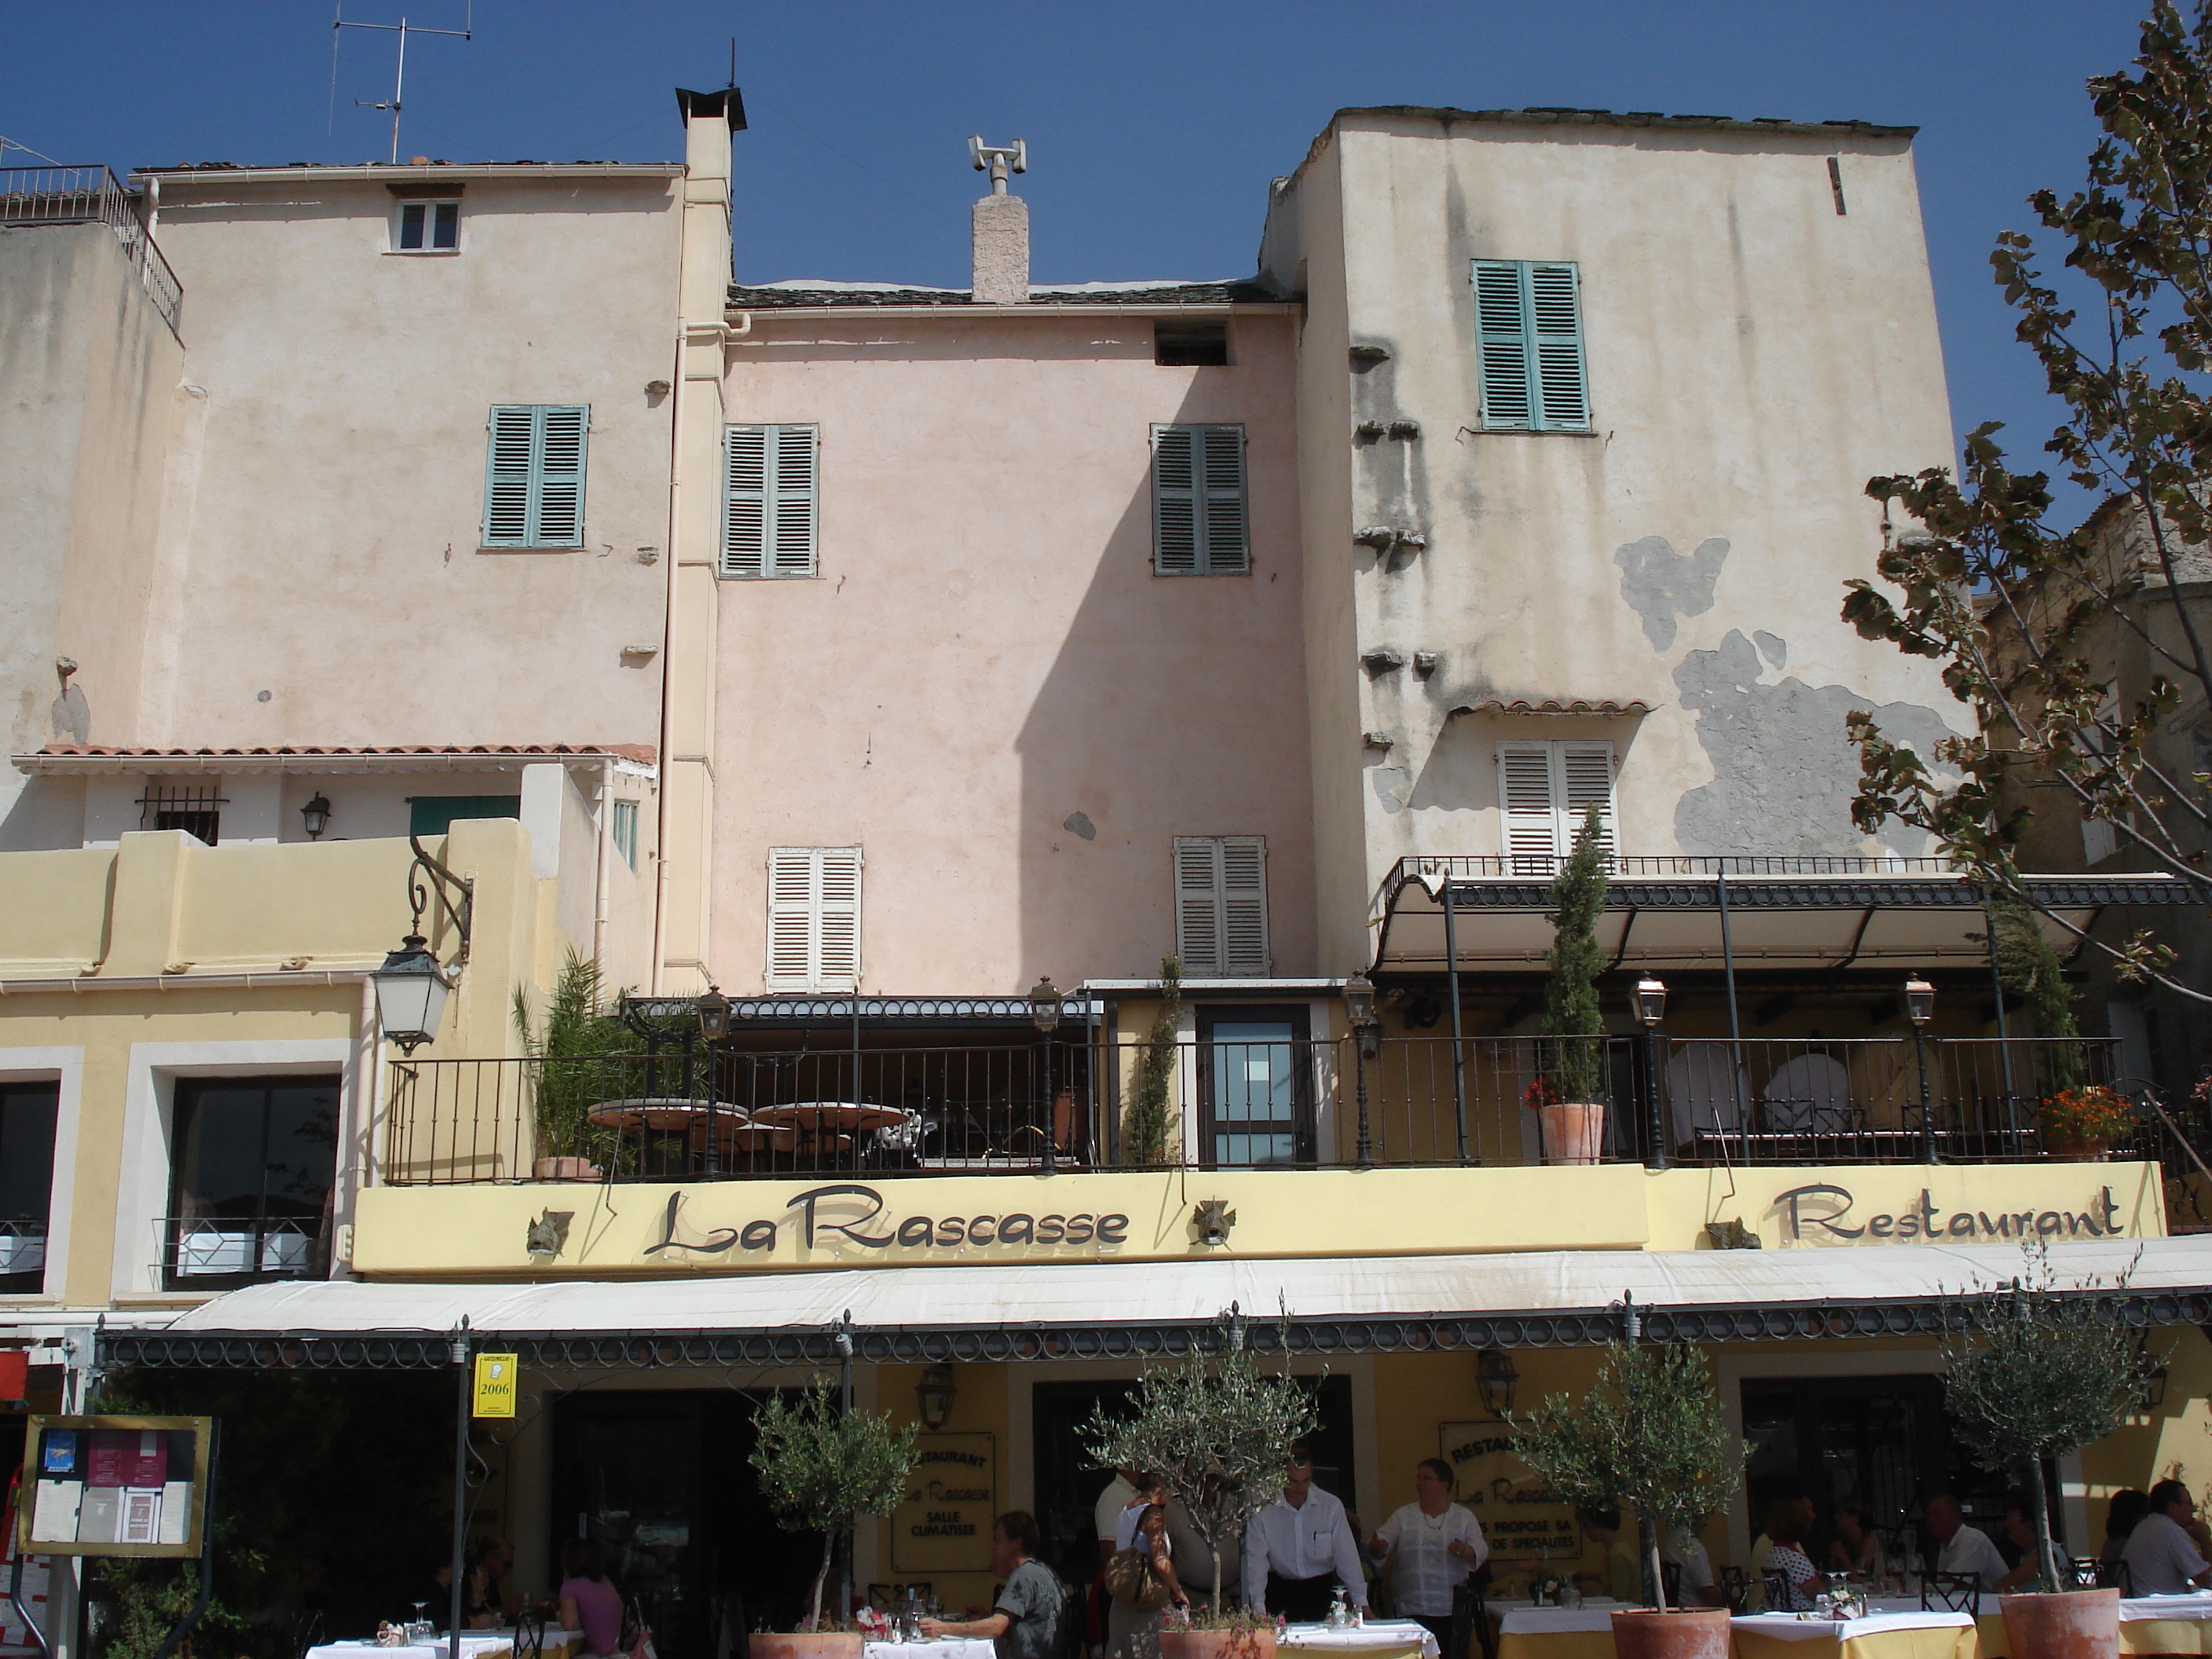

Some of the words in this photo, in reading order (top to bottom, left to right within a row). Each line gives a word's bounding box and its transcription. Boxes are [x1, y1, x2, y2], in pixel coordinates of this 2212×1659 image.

[1774, 1184, 2125, 1240] Restaurant
[643, 1190, 778, 1255] La
[786, 1184, 1130, 1250] Rascasse
[481, 1382, 509, 1395] 2006
[926, 1480, 990, 1501] Rascasse
[1453, 1479, 1484, 1505] La
[926, 1511, 960, 1523] SALLE
[911, 1524, 976, 1536] CLIMATISEE
[1495, 1519, 1549, 1533] PROPOSE
[1556, 1519, 1572, 1531] SA
[1492, 1538, 1507, 1550] DE
[1512, 1536, 1574, 1549] SPECIALITES
